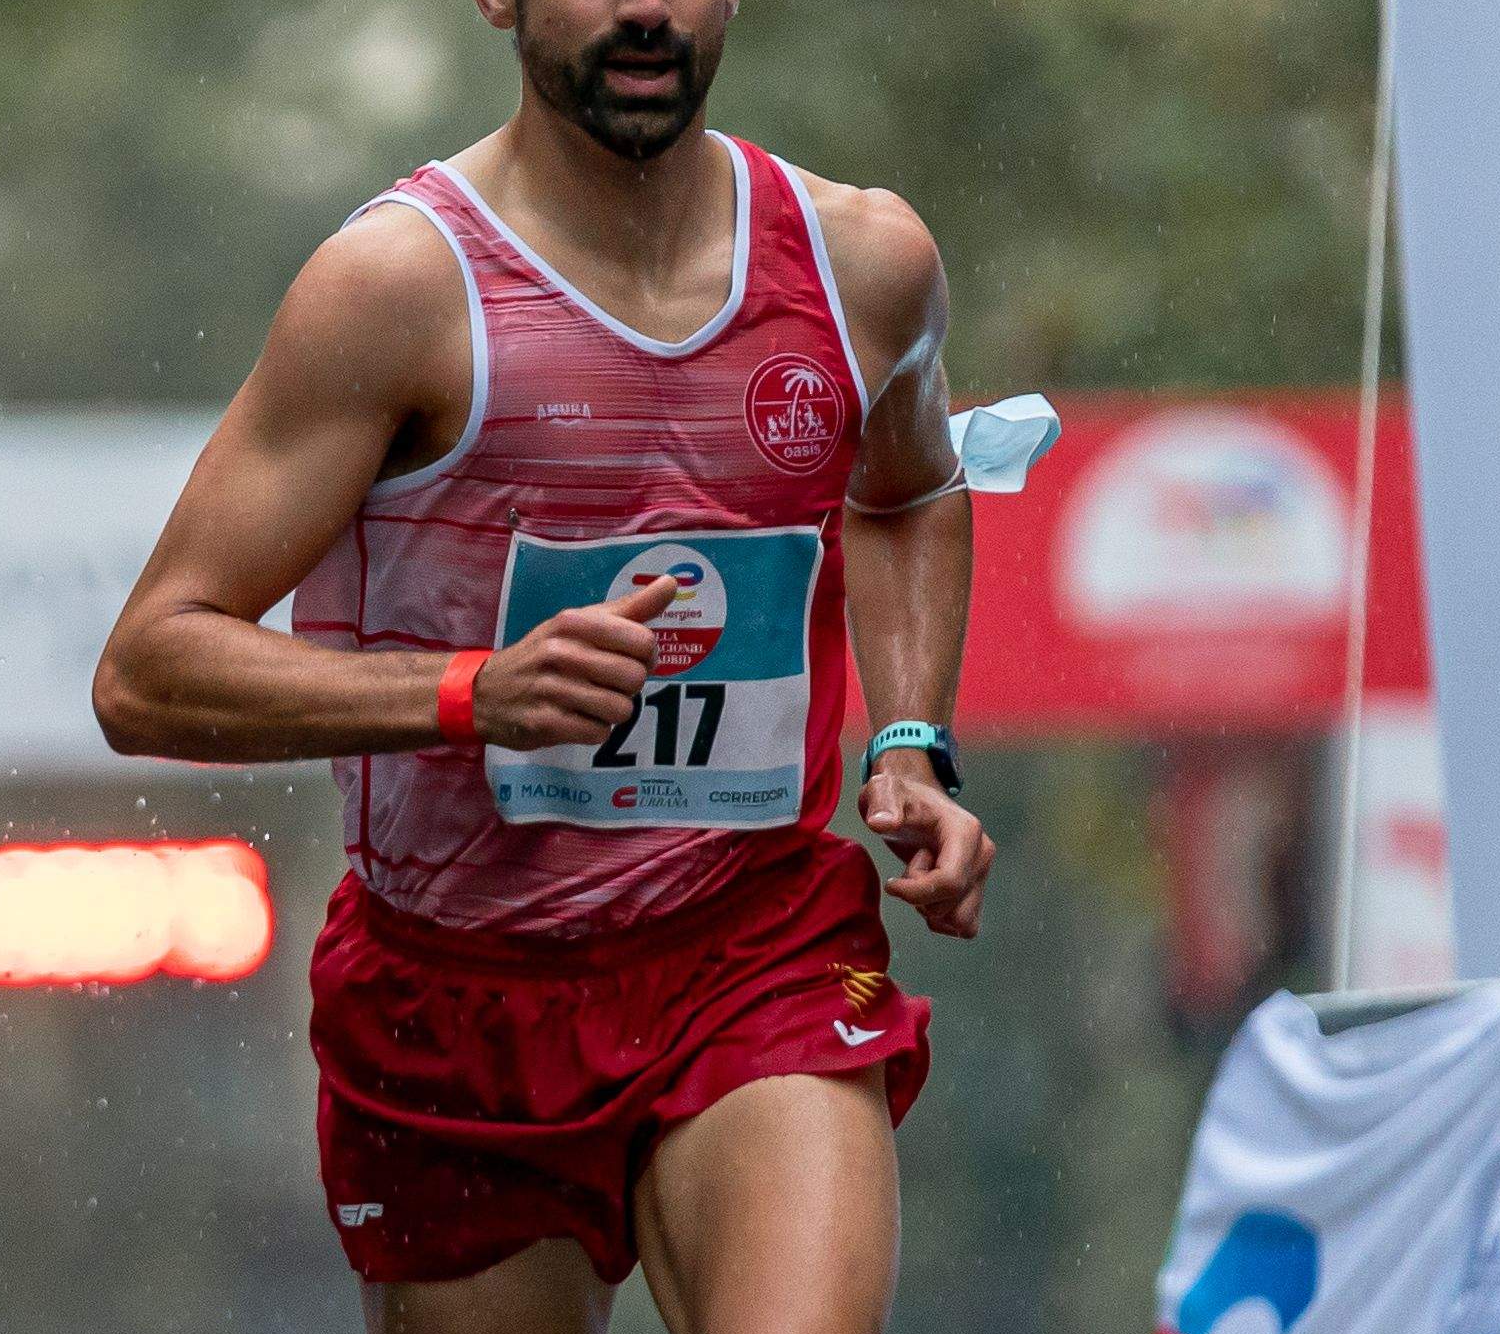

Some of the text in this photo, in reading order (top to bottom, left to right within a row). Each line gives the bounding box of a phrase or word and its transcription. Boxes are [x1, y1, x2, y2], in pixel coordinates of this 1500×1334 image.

[592, 683, 726, 767] 217
[520, 784, 592, 804] MADRID
[641, 785, 683, 796] MILLA
